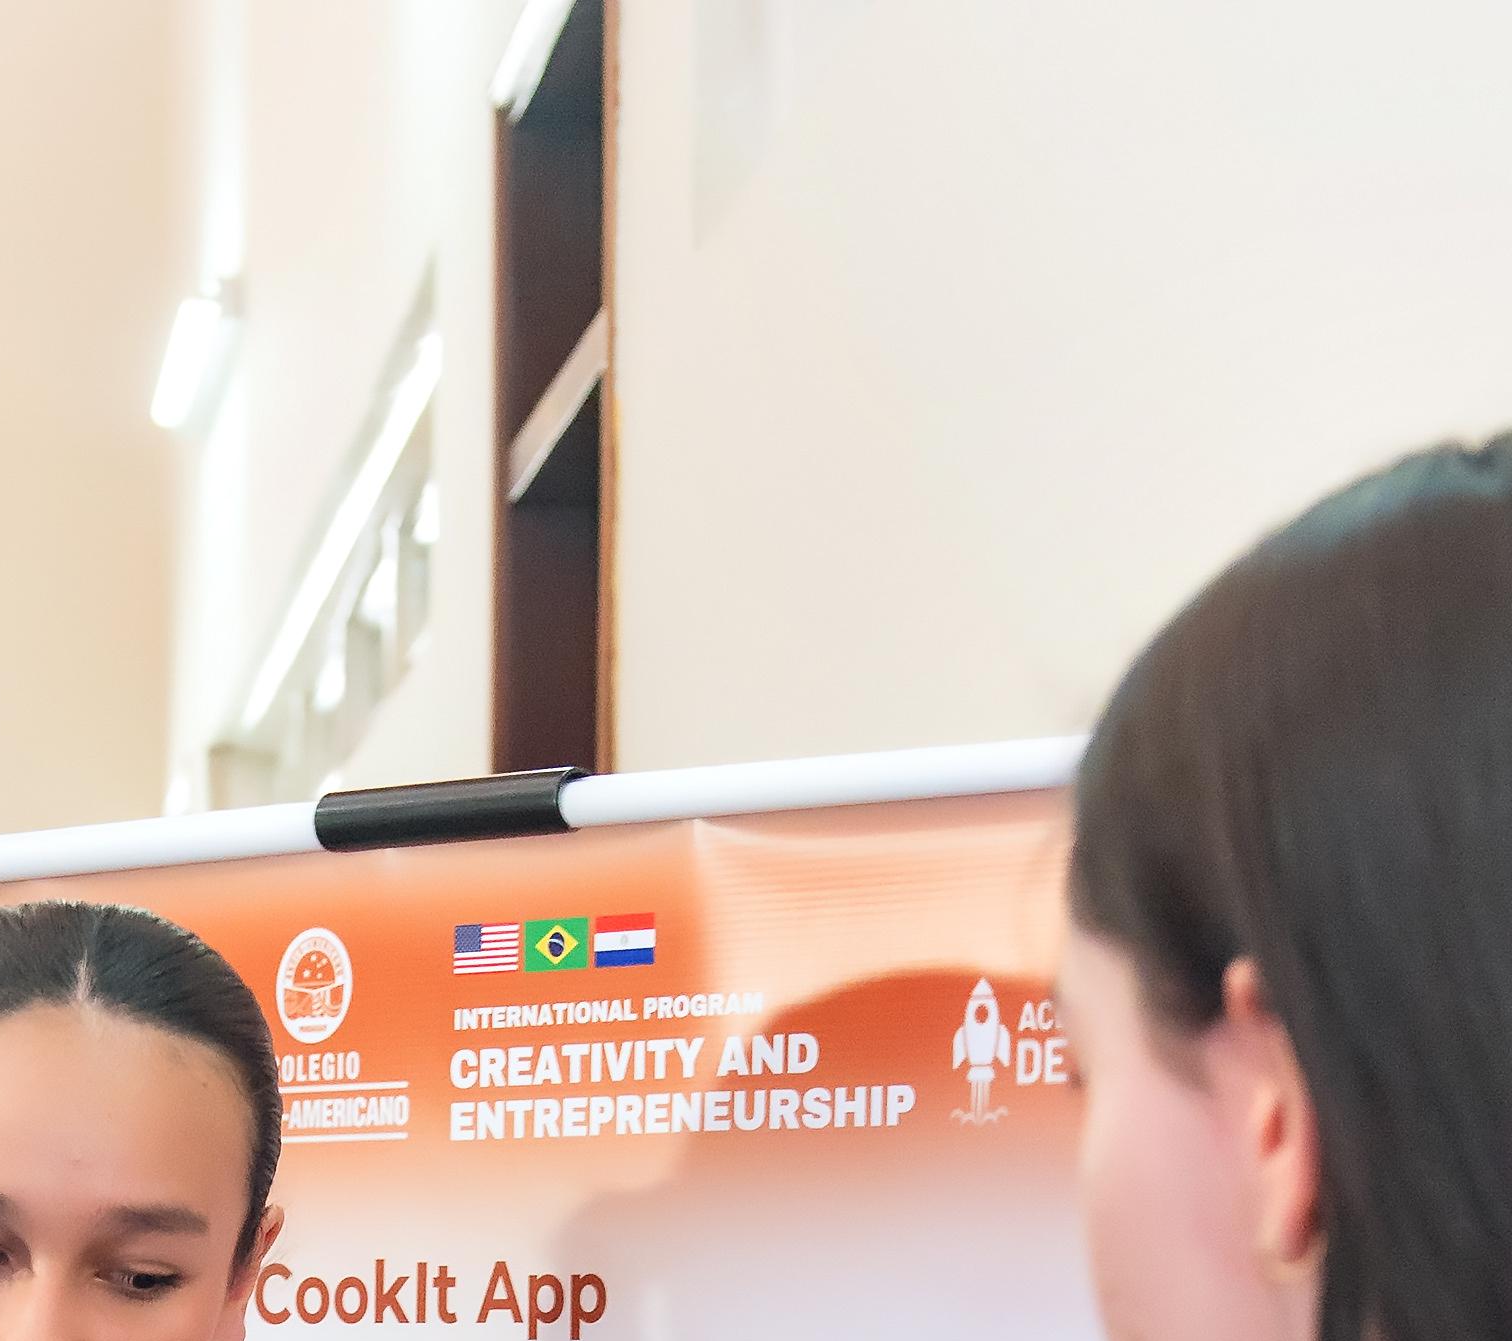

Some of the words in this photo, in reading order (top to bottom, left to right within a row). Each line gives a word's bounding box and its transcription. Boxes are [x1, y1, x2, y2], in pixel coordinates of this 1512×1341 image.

[453, 999, 638, 1032] INTERNATIONAL
[642, 991, 764, 1022] PROGRAM
[1018, 1001, 1064, 1034] AC
[275, 1050, 361, 1083] OLEGIO
[449, 1036, 705, 1090] CREATIVITY
[715, 1032, 821, 1078] AND
[449, 1084, 917, 1142] ENTREPRENEURSHIP
[253, 1258, 458, 1326] CookIt
[475, 1260, 608, 1341] App
